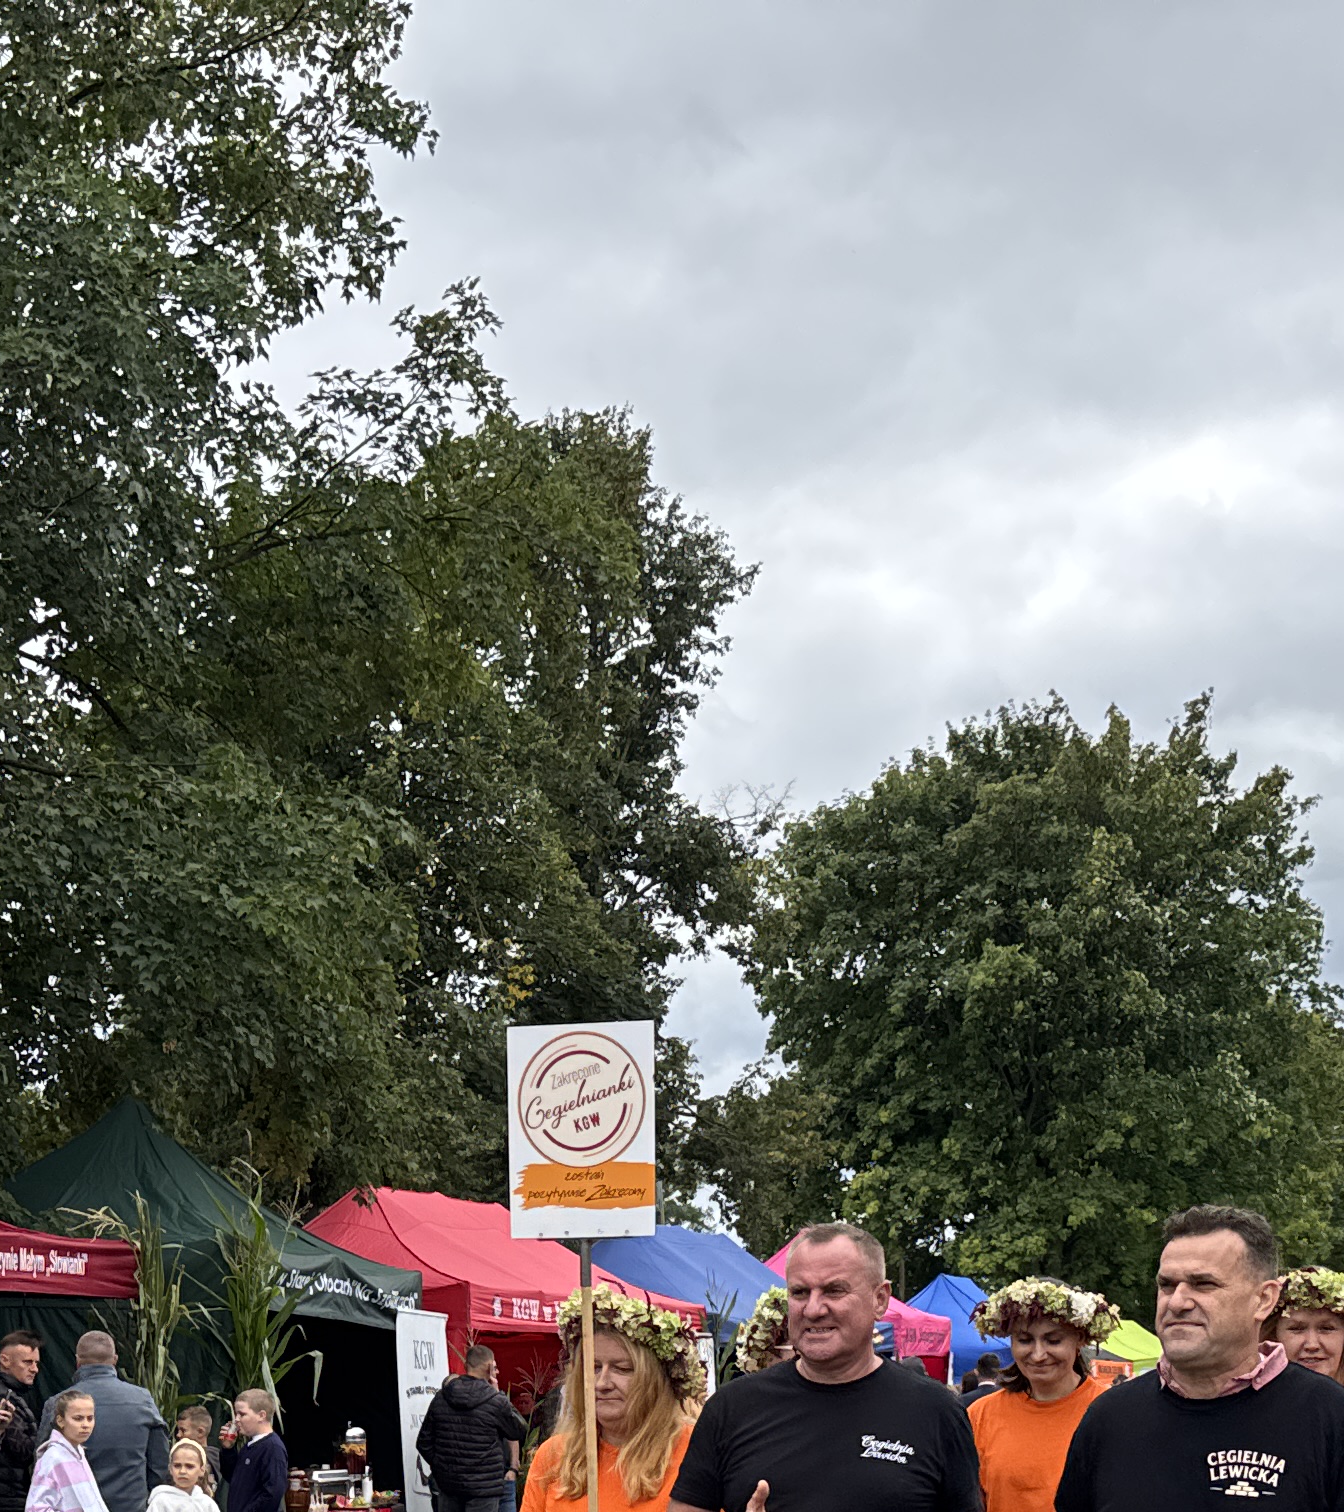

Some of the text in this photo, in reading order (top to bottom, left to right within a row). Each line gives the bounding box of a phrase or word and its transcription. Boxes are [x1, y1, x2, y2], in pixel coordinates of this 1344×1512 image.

[551, 1062, 602, 1091] Zakręcone
[526, 1063, 635, 1130] Cegielnianki
[573, 1112, 601, 1133] KGW
[564, 1168, 605, 1181] zostań
[527, 1184, 647, 1203] pozytywnie Zakręcony
[512, 1297, 540, 1322] KGW
[413, 1340, 435, 1370] KGW
[861, 1434, 915, 1455] Cegielnia
[1207, 1449, 1286, 1473] CEGIELNIA
[1209, 1464, 1279, 1487] LEWICKA
